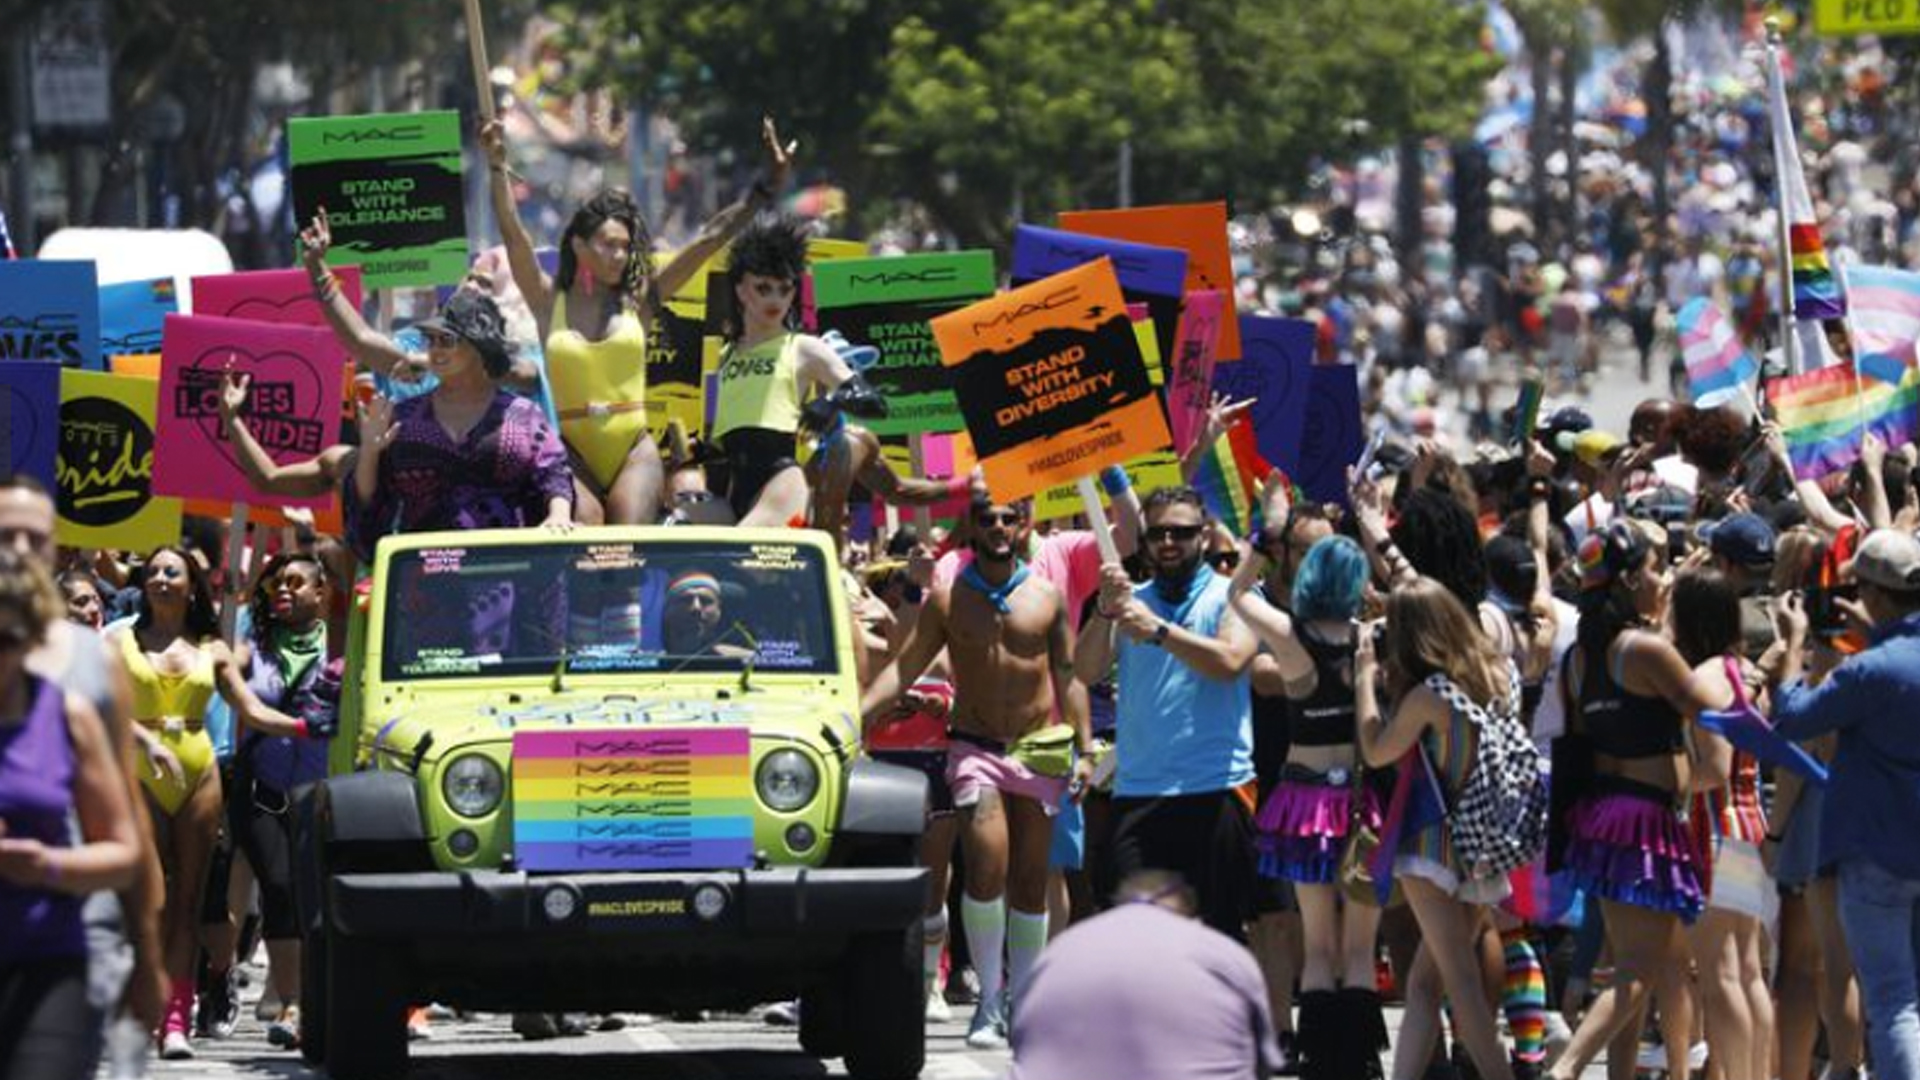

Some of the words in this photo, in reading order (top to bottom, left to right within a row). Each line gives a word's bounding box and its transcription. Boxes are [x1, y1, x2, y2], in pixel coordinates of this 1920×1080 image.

[322, 125, 425, 145] MAC
[341, 178, 415, 195] STAND
[352, 195, 407, 209] WITH
[327, 206, 446, 227] OLERANCE
[851, 268, 957, 288] MAC
[973, 285, 1081, 336] MAC
[869, 323, 935, 339] STAN
[1005, 345, 1085, 385] STAND
[1021, 367, 1081, 398] WITH
[180, 386, 290, 415] LOES
[995, 371, 1114, 426] DIVERSITY
[576, 739, 690, 756] MAC
[577, 760, 691, 777] MAC
[577, 780, 691, 797] MAC
[578, 801, 692, 817] MAC
